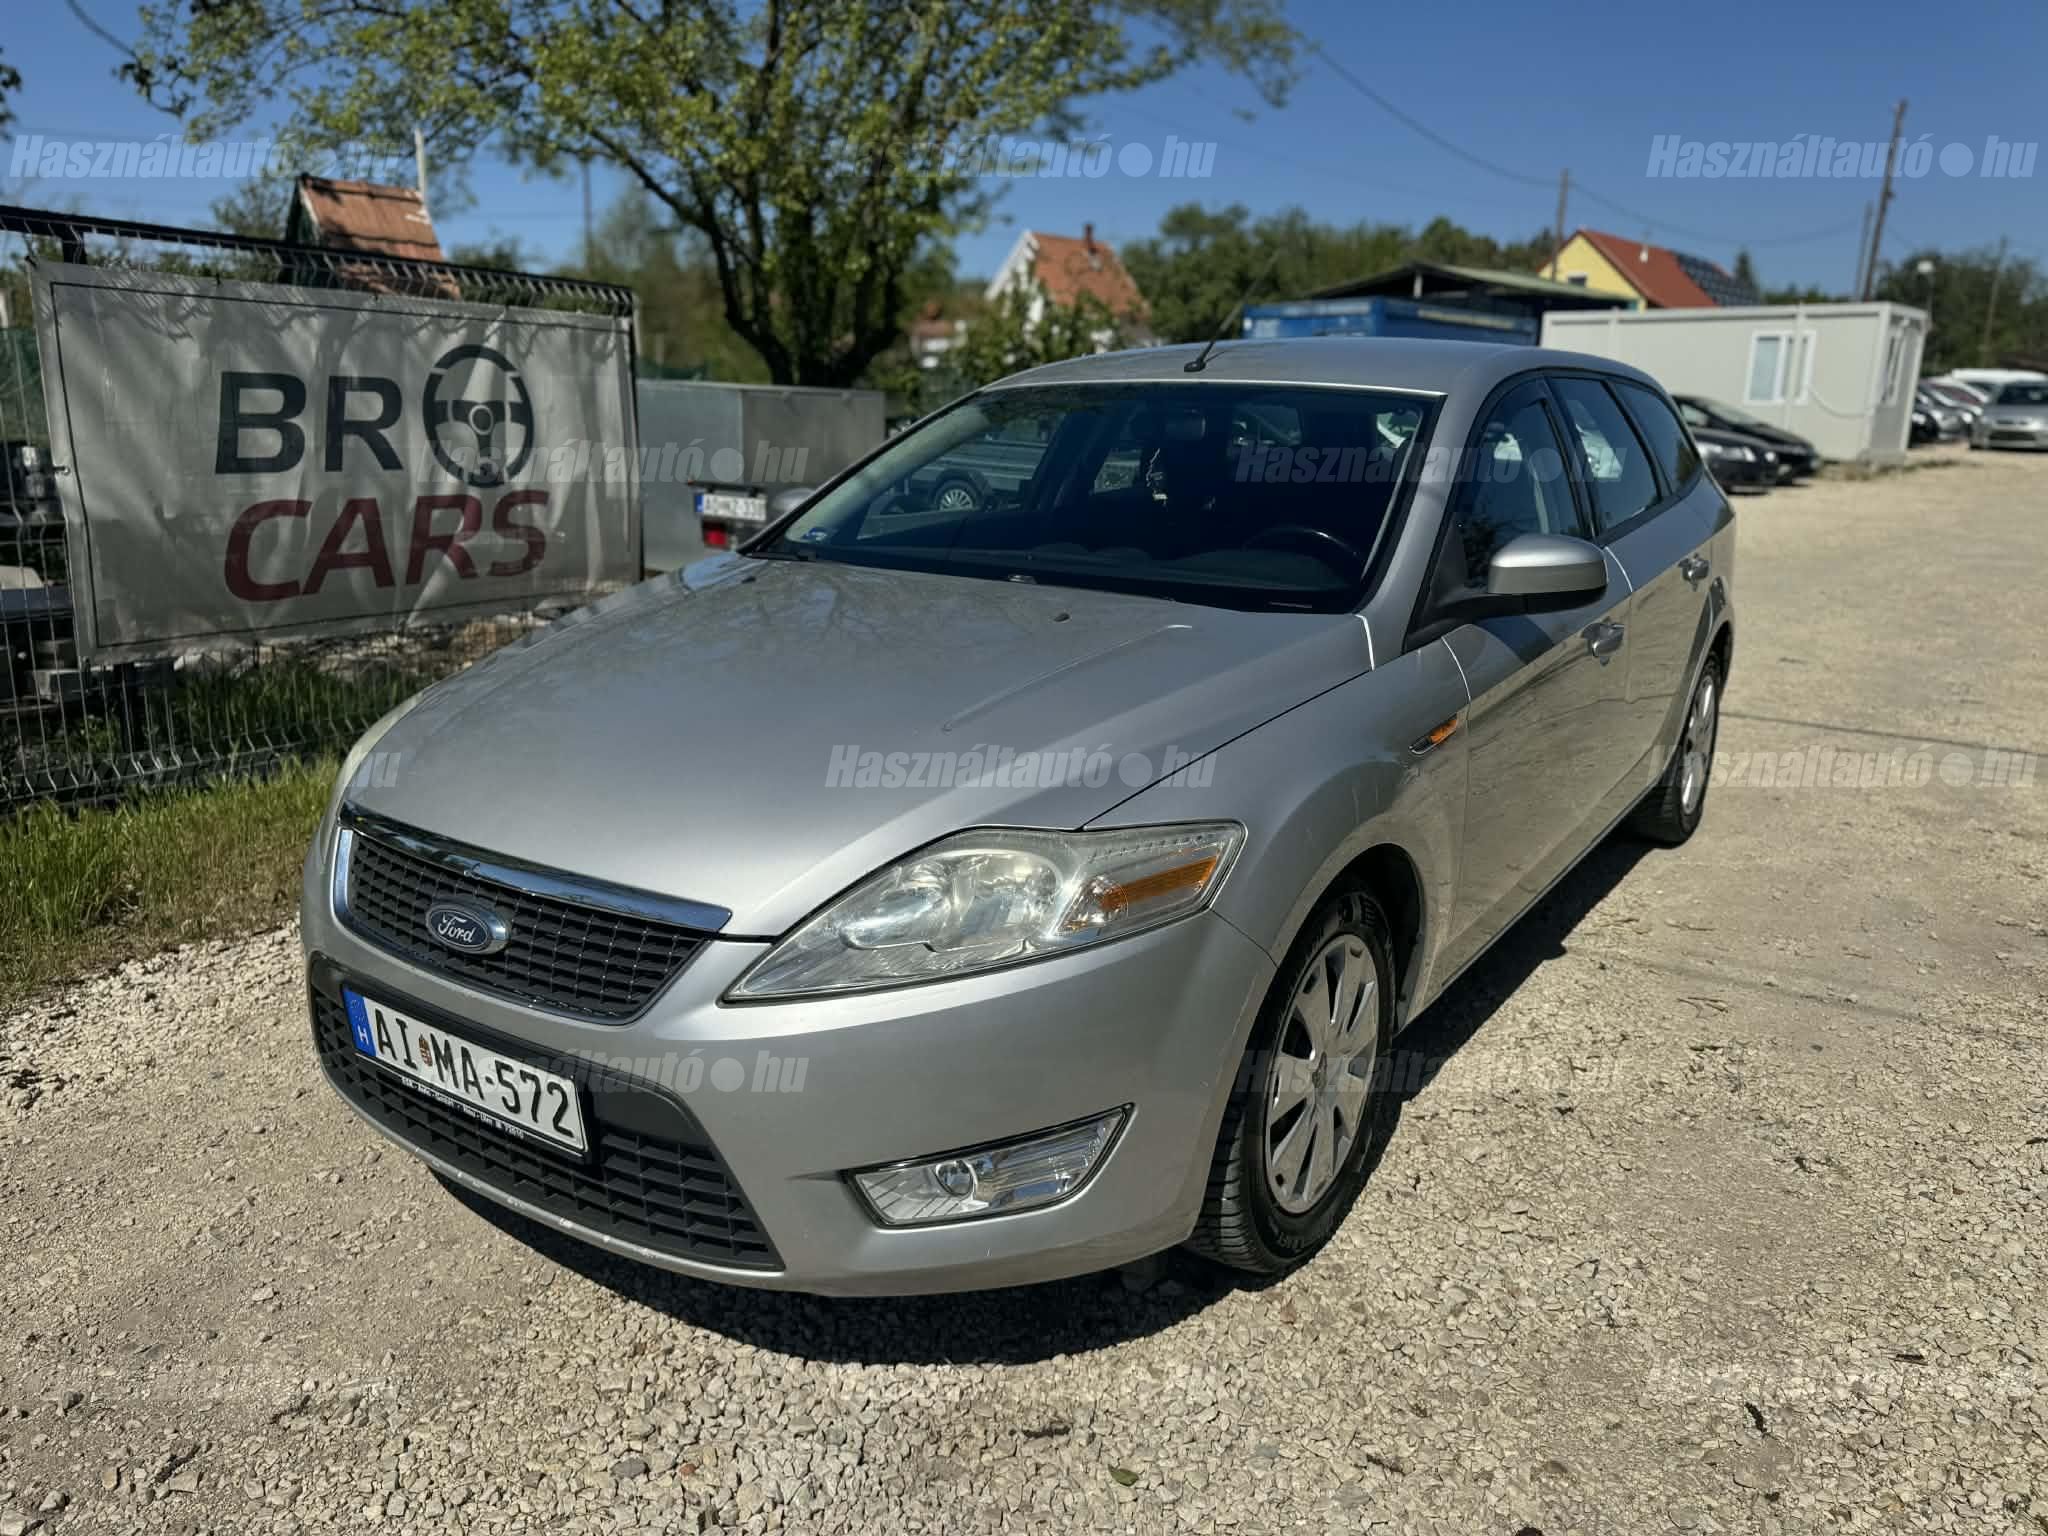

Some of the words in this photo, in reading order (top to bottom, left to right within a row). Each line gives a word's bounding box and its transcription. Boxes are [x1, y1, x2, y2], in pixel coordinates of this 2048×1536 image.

[224, 490, 548, 601] CARS
[438, 912, 477, 943] Ford
[357, 1024, 369, 1045] H
[430, 1032, 575, 1138] MA-572
